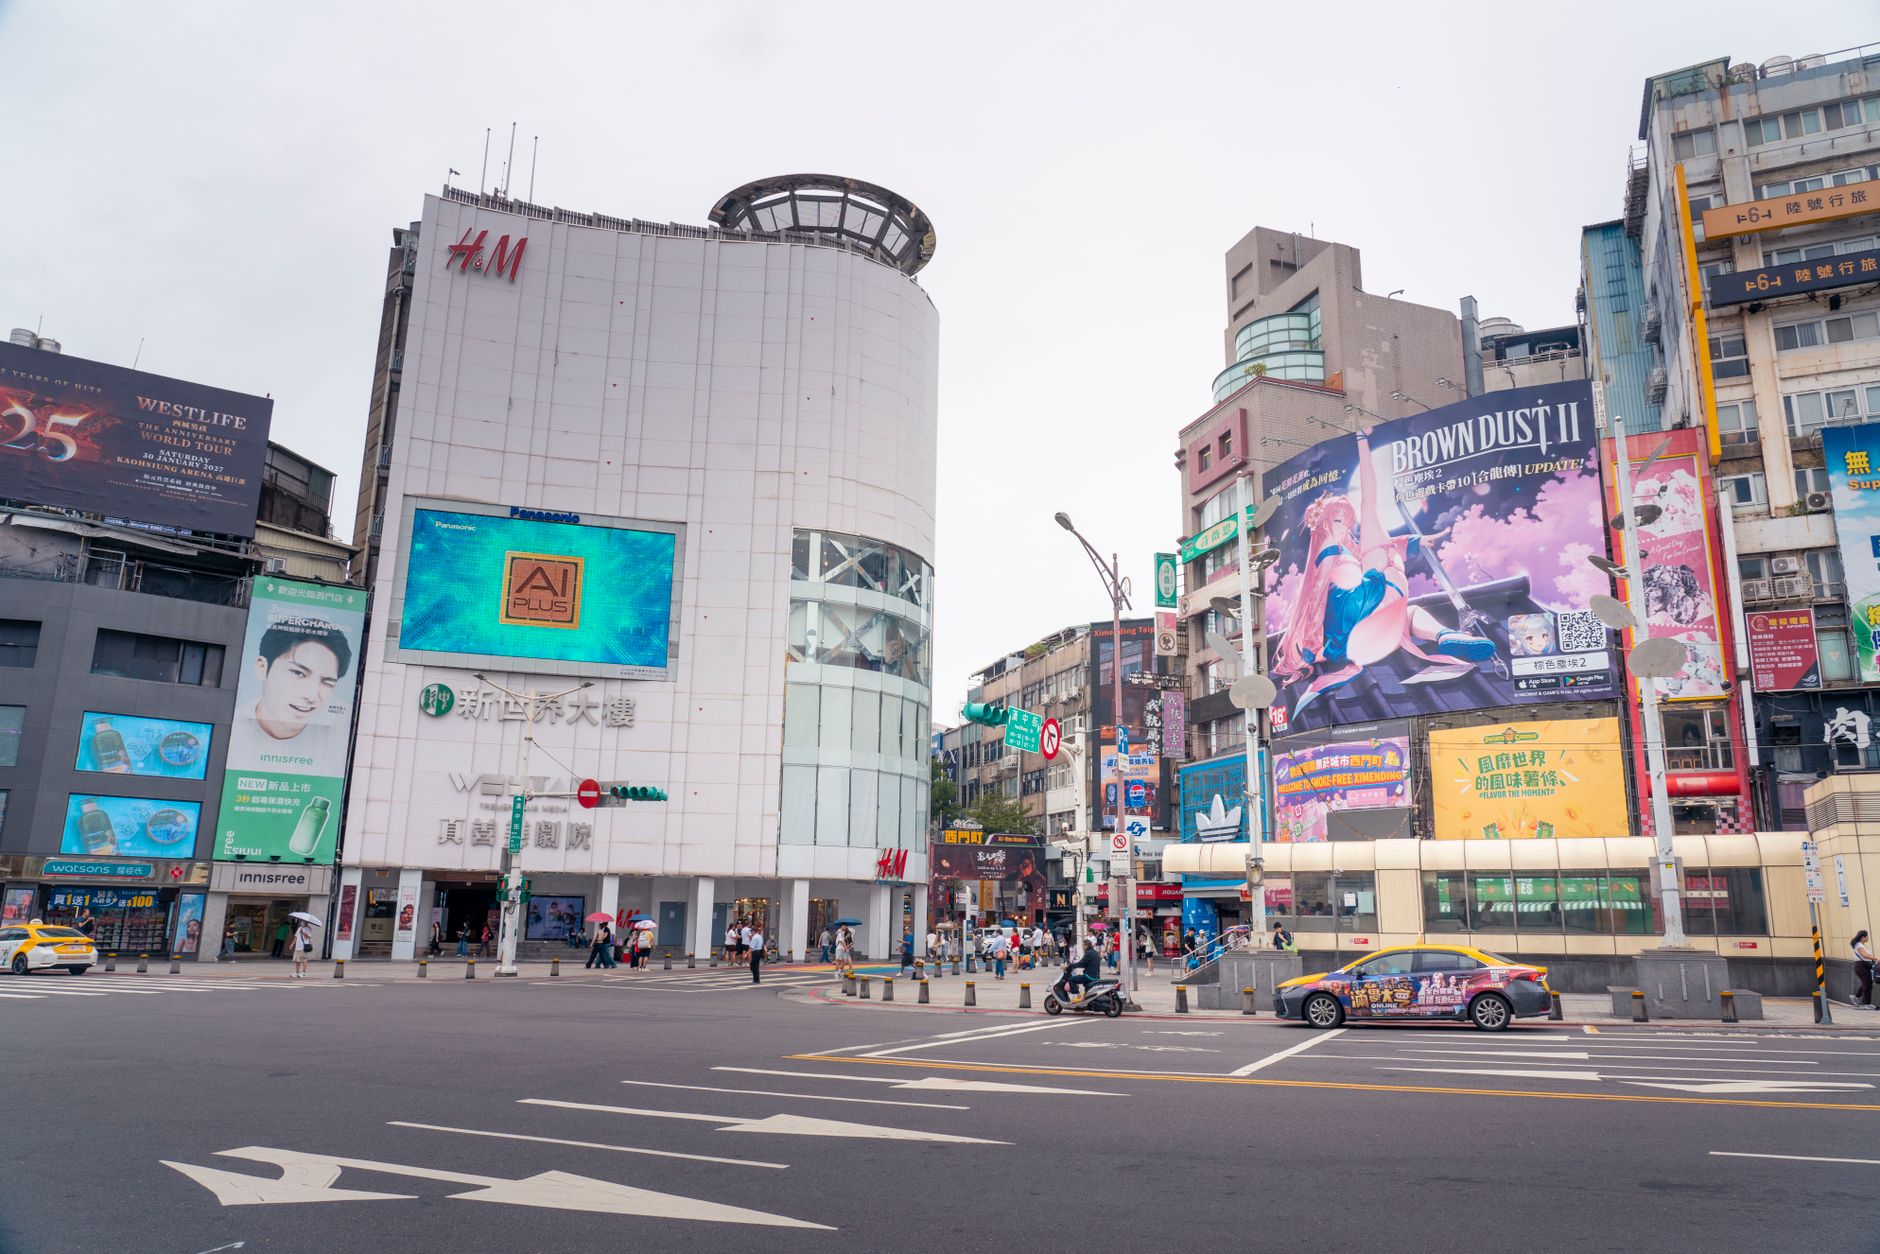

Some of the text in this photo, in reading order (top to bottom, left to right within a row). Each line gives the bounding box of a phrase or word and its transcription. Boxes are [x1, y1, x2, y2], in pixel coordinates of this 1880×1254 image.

[1786, 190, 1868, 215] 陸號行旅
[446, 227, 528, 283] H&M
[1795, 257, 1878, 283] 陸號行旅
[12, 370, 49, 383] YEARS
[136, 395, 247, 431] WESTLIFE
[139, 421, 238, 447] THE ANNIVERSARY
[140, 430, 233, 456] WORLD TOUR
[1391, 417, 1475, 476] BROWN
[1477, 398, 1553, 457] DUST
[142, 452, 225, 474] 30 JANUARY 2027
[159, 449, 211, 464] SATURDAY
[1524, 457, 1586, 476] UPDATE!
[1845, 450, 1871, 475] 無
[116, 456, 178, 474] KAOHSIUNG
[181, 468, 214, 480] ARENA
[510, 505, 580, 523] Panasonic
[435, 521, 477, 531] Panasonic
[514, 565, 568, 598] AI
[278, 585, 343, 604] 歡迎光臨西門店
[513, 597, 567, 613] PLUS
[1094, 626, 1137, 637] Ximeding
[457, 688, 637, 728] 新世界大樓
[1823, 706, 1872, 749] 肉
[239, 779, 311, 793] NEW 新品上市
[1354, 770, 1402, 786] XIMENDING
[1508, 789, 1520, 798] THE
[944, 829, 983, 846] 西門町
[53, 863, 144, 876] watsons 屈臣氏
[876, 847, 908, 880] H&M
[1057, 894, 1066, 906] N
